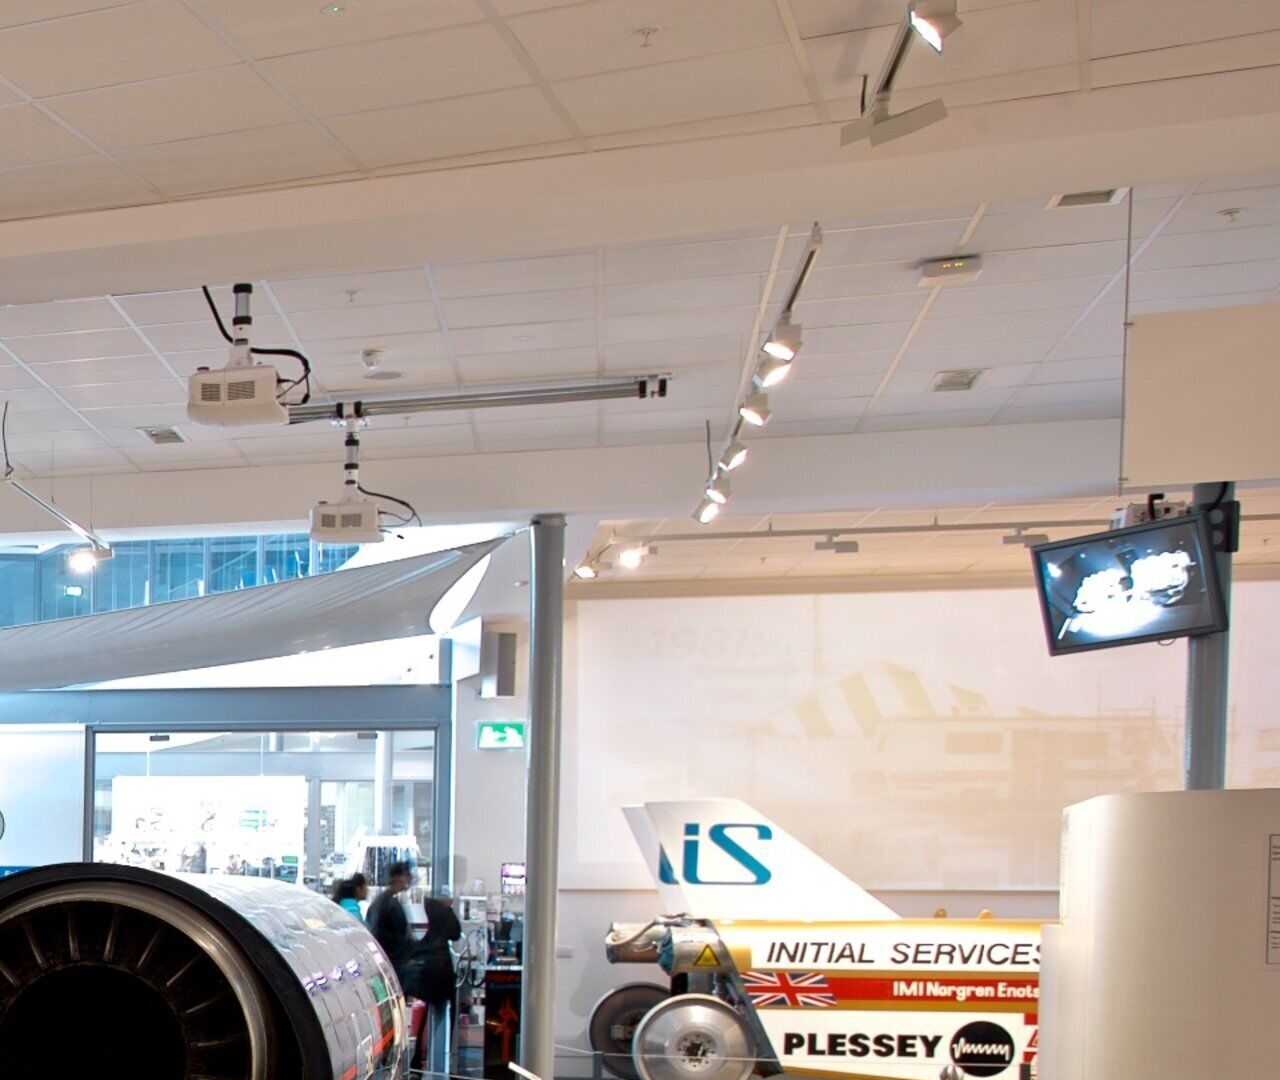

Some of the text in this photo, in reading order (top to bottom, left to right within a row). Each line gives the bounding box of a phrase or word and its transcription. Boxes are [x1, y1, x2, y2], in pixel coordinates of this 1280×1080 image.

[766, 942, 876, 964] INITIAL
[893, 981, 924, 997] IMI
[926, 981, 995, 1001] Norgren
[784, 1032, 943, 1058] PLESSEY
